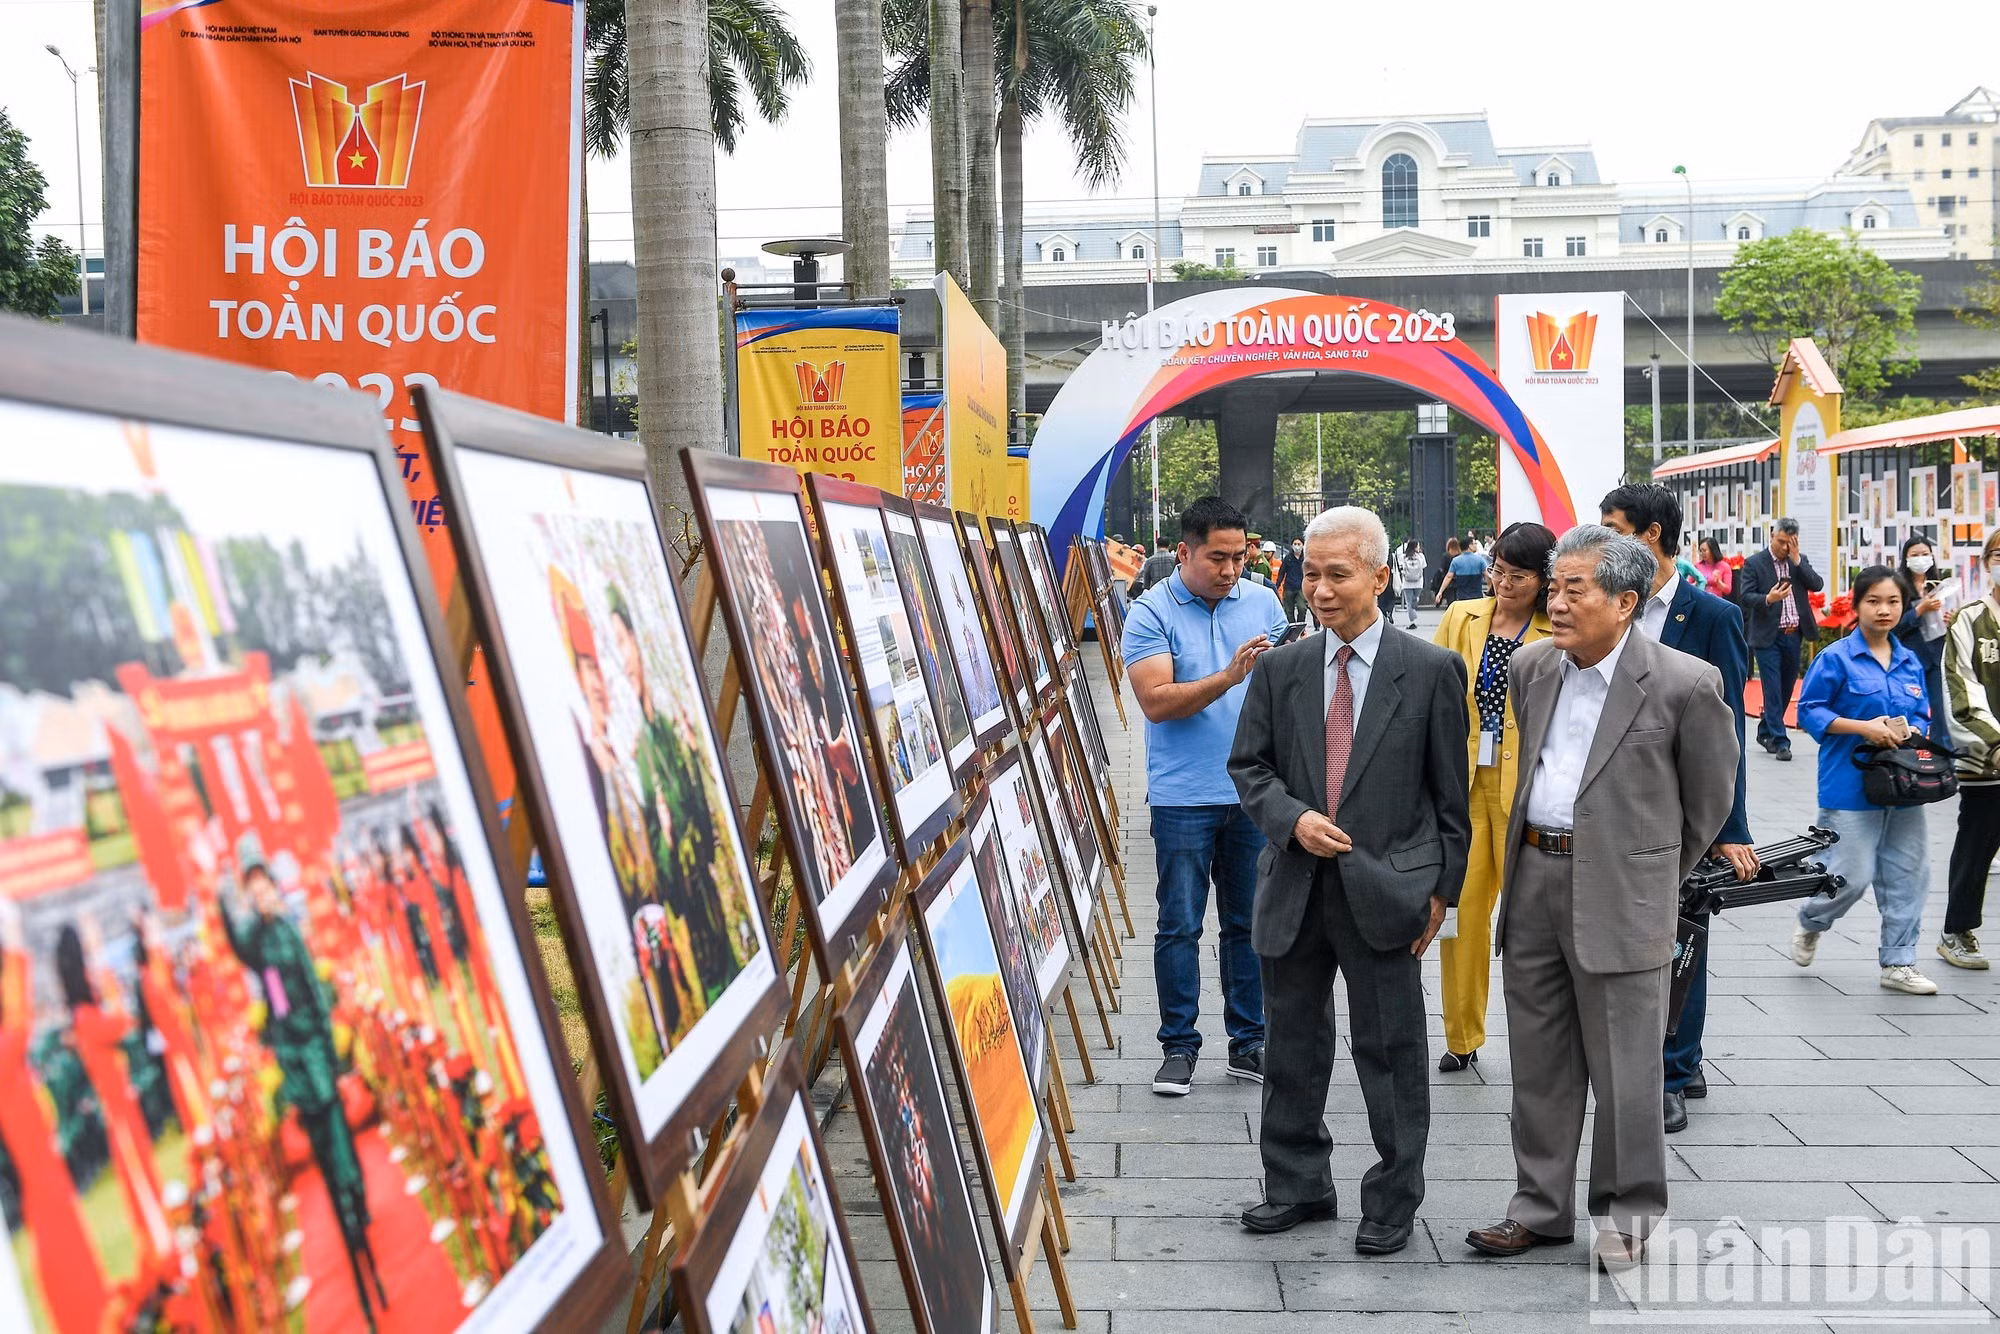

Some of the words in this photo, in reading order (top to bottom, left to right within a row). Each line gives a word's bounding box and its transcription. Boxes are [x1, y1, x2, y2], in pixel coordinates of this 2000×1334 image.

[290, 192, 308, 208] HỘI
[312, 192, 333, 206] BÁO
[336, 192, 364, 206] TOÀN
[367, 192, 396, 208] QUỐC
[398, 195, 424, 208] 2023
[224, 217, 337, 291] HỘI
[358, 218, 486, 279] BÁO
[210, 293, 344, 342] TOÀN
[358, 291, 497, 348] QUỐC
[1101, 311, 1150, 357] HỘI
[1159, 308, 1216, 349] BÁO
[1221, 309, 1296, 346] TOÀN
[1303, 302, 1380, 348] QUỐC
[1387, 310, 1456, 343] 2023
[1161, 354, 1186, 367] ĐOÀN
[1188, 353, 1206, 366] KẾT,
[1208, 351, 1244, 364] CHUYÊN
[1246, 350, 1280, 362] NGHIỆP,
[1283, 349, 1301, 360] VĂN
[1302, 349, 1322, 360] HÓA,
[1325, 348, 1349, 360] SÁNG
[1352, 350, 1369, 360] TẠO
[772, 415, 814, 444] HỘI
[821, 414, 871, 438] BÁO
[768, 444, 818, 463] TOÀN
[822, 442, 876, 464] QUỐC
